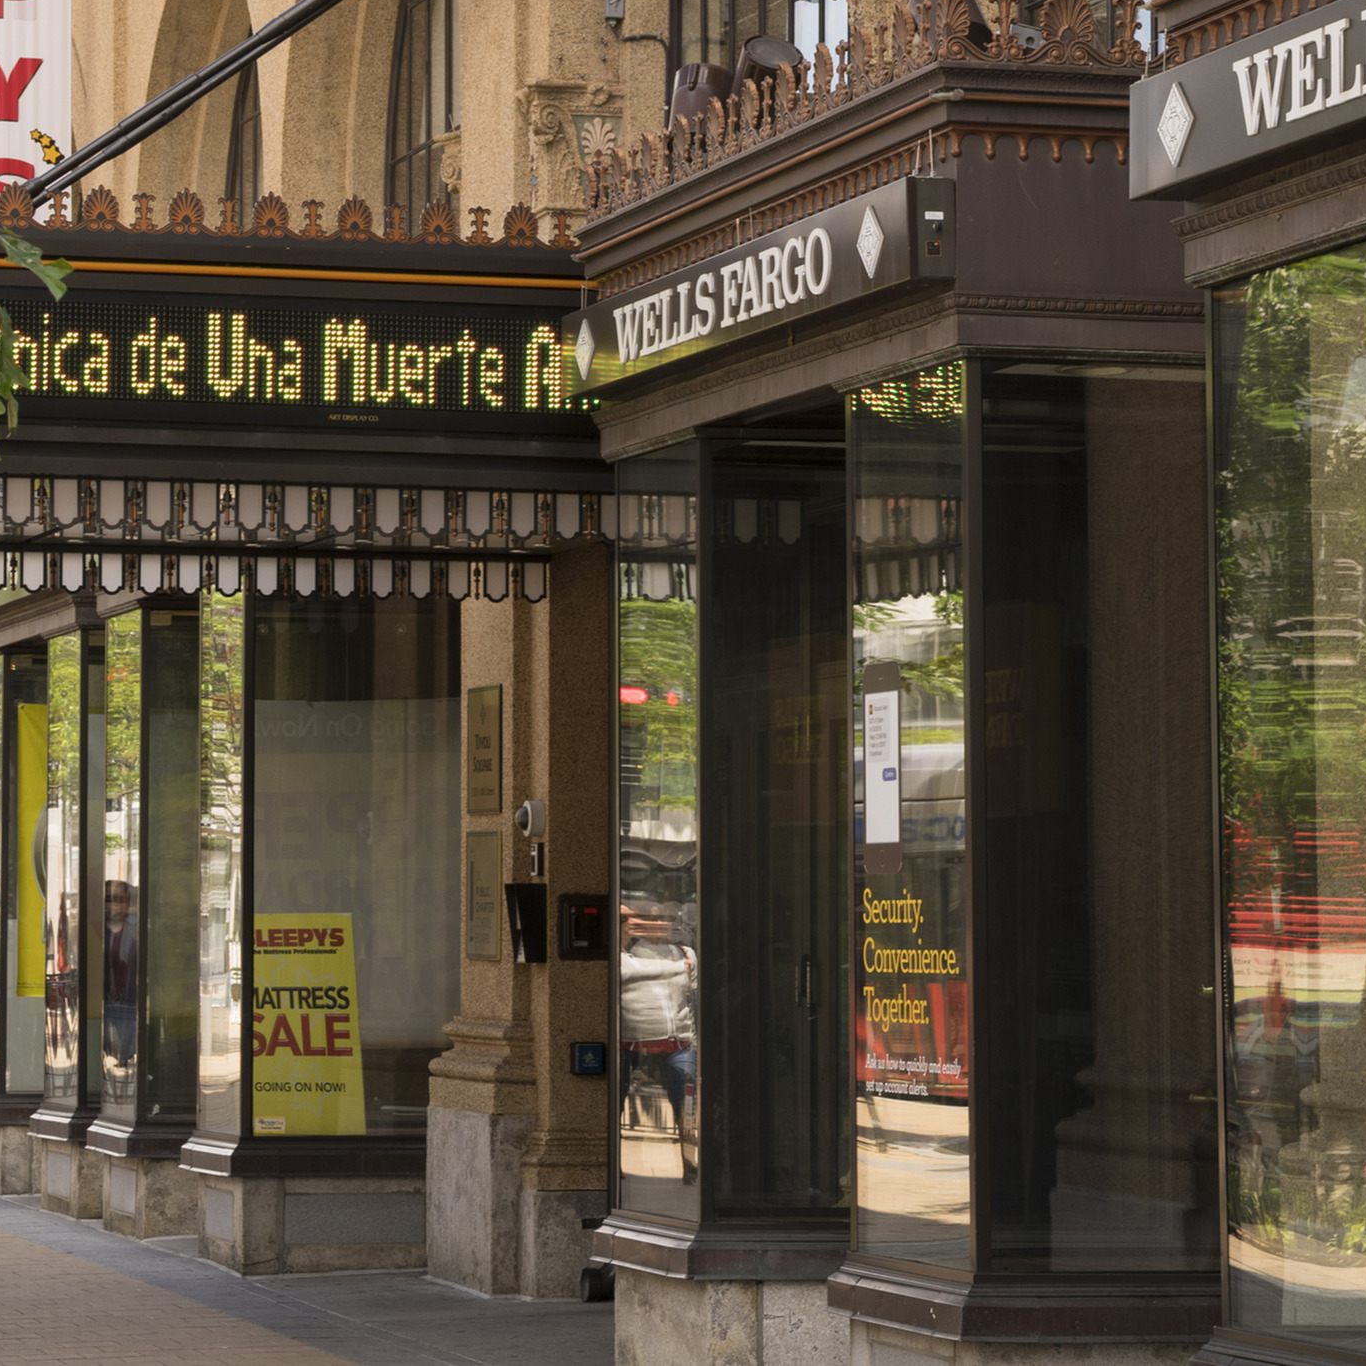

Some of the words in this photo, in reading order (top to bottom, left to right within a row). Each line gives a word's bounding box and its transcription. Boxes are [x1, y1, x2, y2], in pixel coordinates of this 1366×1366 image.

[613, 272, 716, 364] WELLS
[720, 227, 833, 328] FARGO
[131, 317, 185, 395] de
[207, 312, 302, 400] Una
[323, 319, 504, 406] Muerte
[863, 887, 924, 933] Security.
[252, 928, 345, 947] LEEPYS
[863, 936, 960, 975] Convenience.
[863, 984, 930, 1032] Together.
[865, 1053, 876, 1069] Ask
[886, 1053, 899, 1070] how
[899, 1058, 906, 1071] to
[906, 1055, 928, 1077] quickly
[928, 1057, 942, 1073] and
[942, 1058, 961, 1079] easily
[254, 1081, 292, 1093] GOING
[295, 1081, 312, 1092] ON
[315, 1082, 346, 1093] NOW!
[875, 1081, 884, 1096] up
[884, 1082, 909, 1094] account
